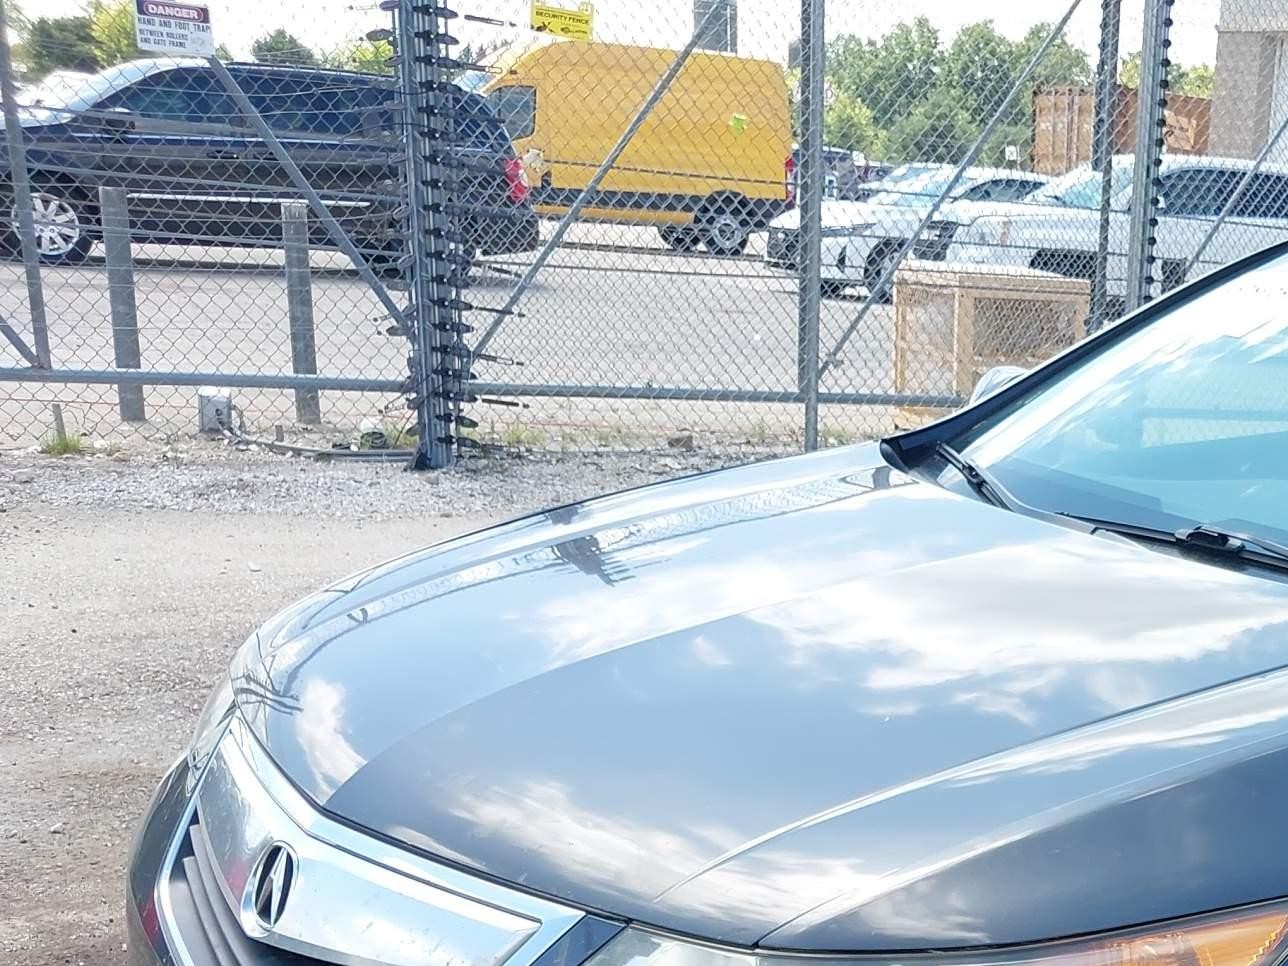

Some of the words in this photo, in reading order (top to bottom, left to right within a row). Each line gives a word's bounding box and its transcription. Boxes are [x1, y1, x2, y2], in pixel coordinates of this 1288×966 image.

[148, 4, 199, 19] DANGER
[536, 11, 568, 22] SECURITY
[569, 17, 589, 25] FENCE
[138, 17, 156, 27] HAND
[159, 20, 172, 29] AND
[175, 22, 190, 31] FOOT
[193, 24, 210, 33] TRAP
[139, 29, 164, 38] BETWEEN
[154, 38, 166, 46] GATE
[169, 40, 186, 48] FRAME
